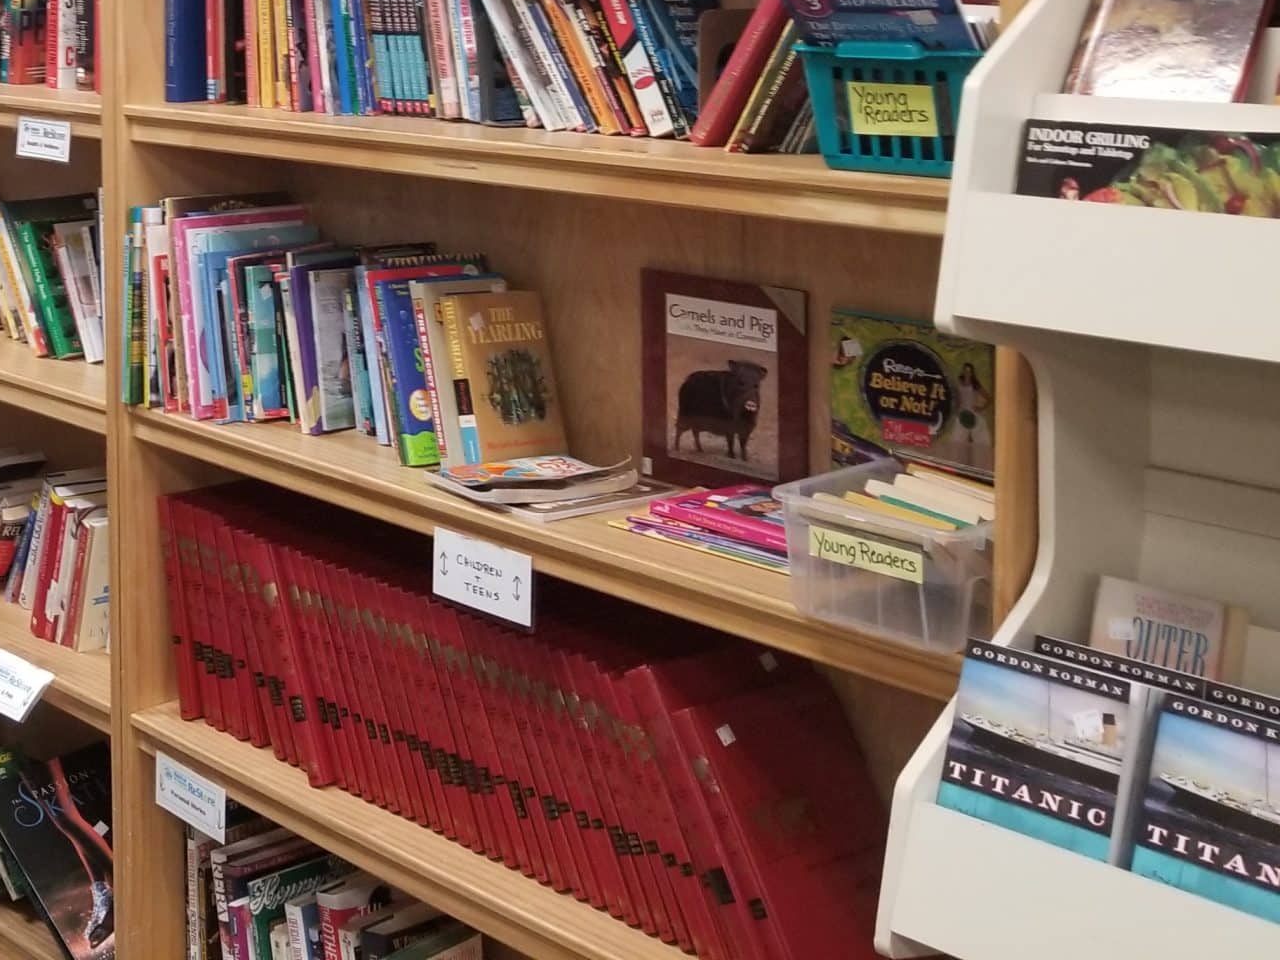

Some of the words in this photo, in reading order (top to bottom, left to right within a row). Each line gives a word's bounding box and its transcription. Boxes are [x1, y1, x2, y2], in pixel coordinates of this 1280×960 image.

[852, 86, 908, 114] Young
[863, 105, 929, 125] Readers
[1028, 127, 1084, 144] INDOOR
[1085, 131, 1150, 149] GRILLING
[719, 314, 745, 329] and
[749, 315, 774, 339] Pigs
[870, 372, 927, 396] Believe
[930, 383, 947, 400] It
[879, 396, 899, 409] or
[899, 394, 937, 417] Not!
[456, 554, 503, 578] CHILDREN
[813, 531, 857, 565] Young
[859, 542, 917, 574] Readers
[463, 581, 501, 601] TEENS
[972, 646, 1044, 673] GORDON
[1048, 668, 1126, 697] KORMAN
[1040, 642, 1114, 668] GORDON
[1119, 663, 1198, 691] KORMAN
[1172, 701, 1259, 733] GORDON
[949, 759, 1108, 828] TITANIC
